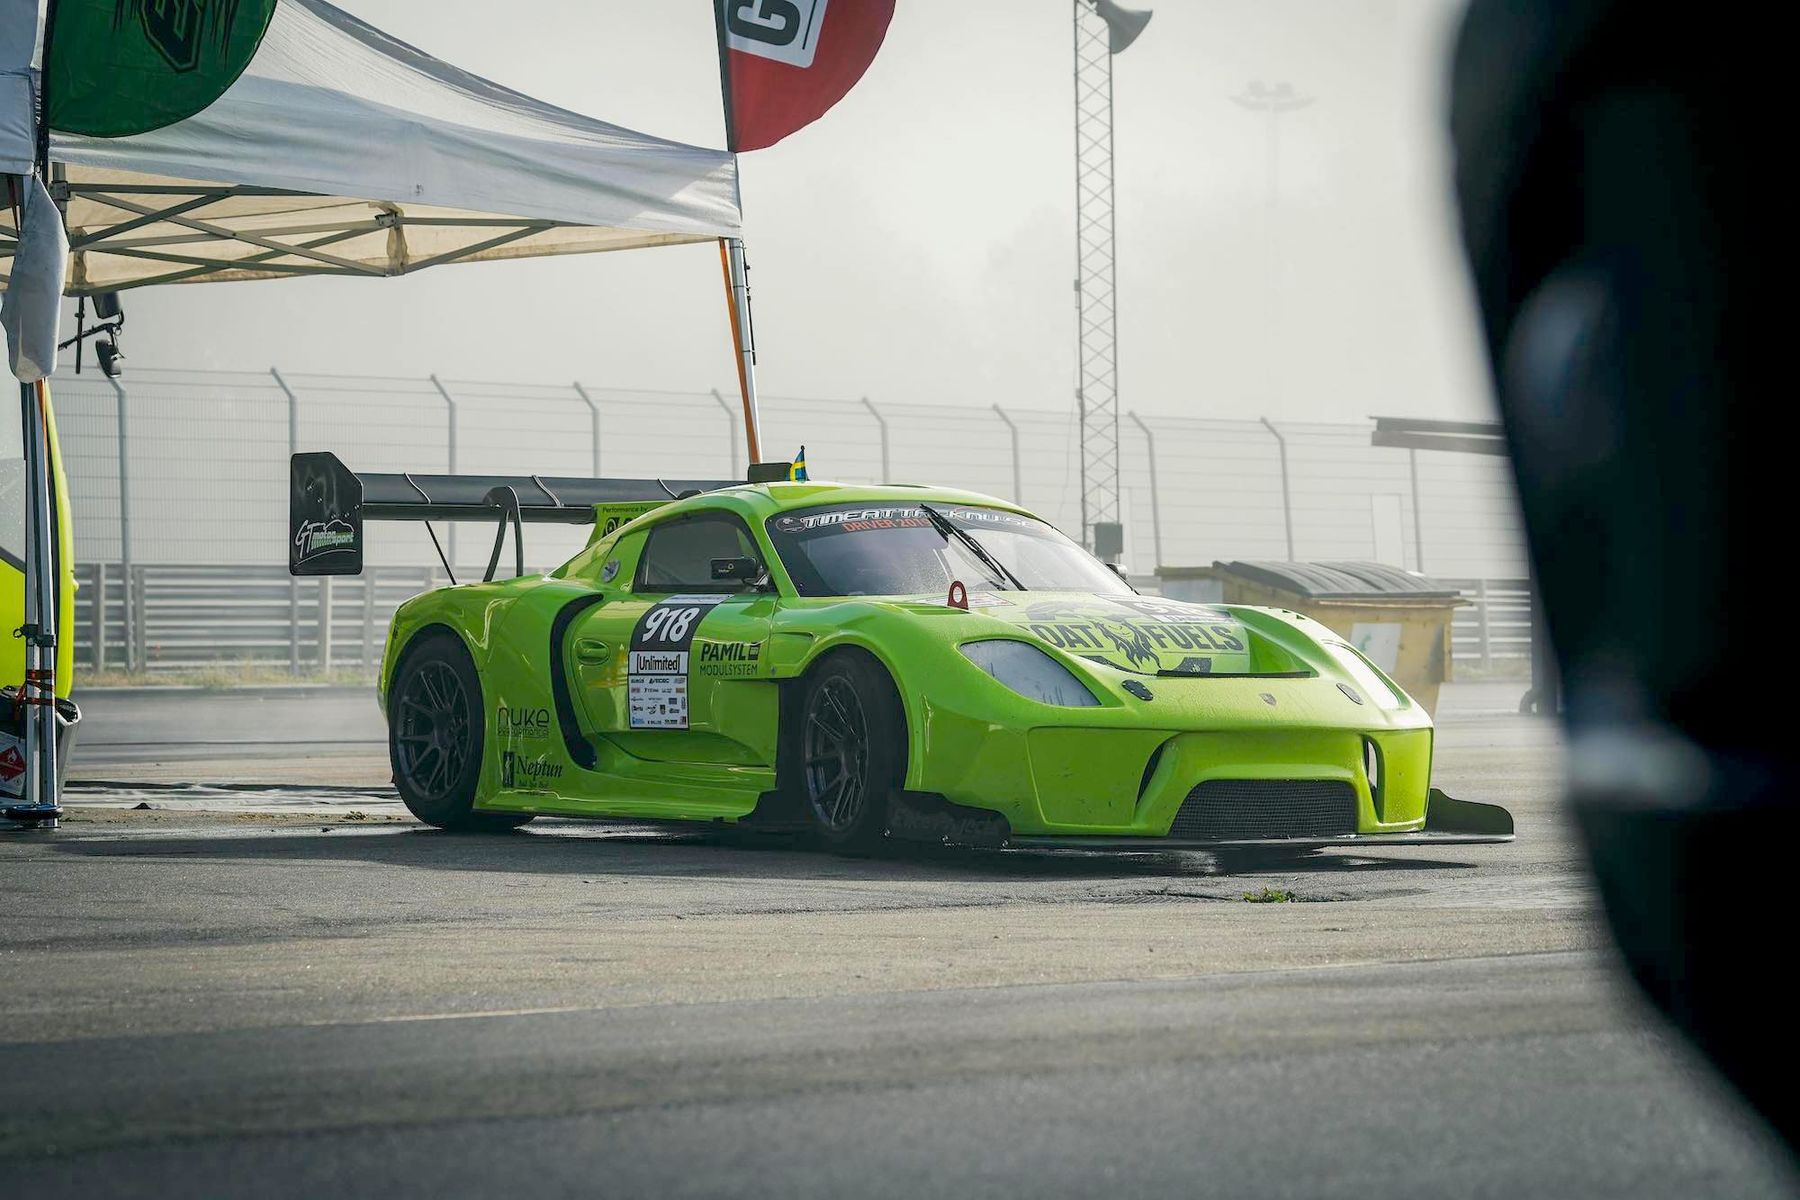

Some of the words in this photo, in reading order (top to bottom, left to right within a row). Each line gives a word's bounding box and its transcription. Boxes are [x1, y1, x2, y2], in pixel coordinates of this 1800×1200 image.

[842, 519, 896, 533] DRIVER
[642, 607, 700, 642] 918
[1139, 624, 1245, 651] FUELS
[699, 663, 758, 676] MODULSYSTEM
[516, 756, 563, 781] Neptun
